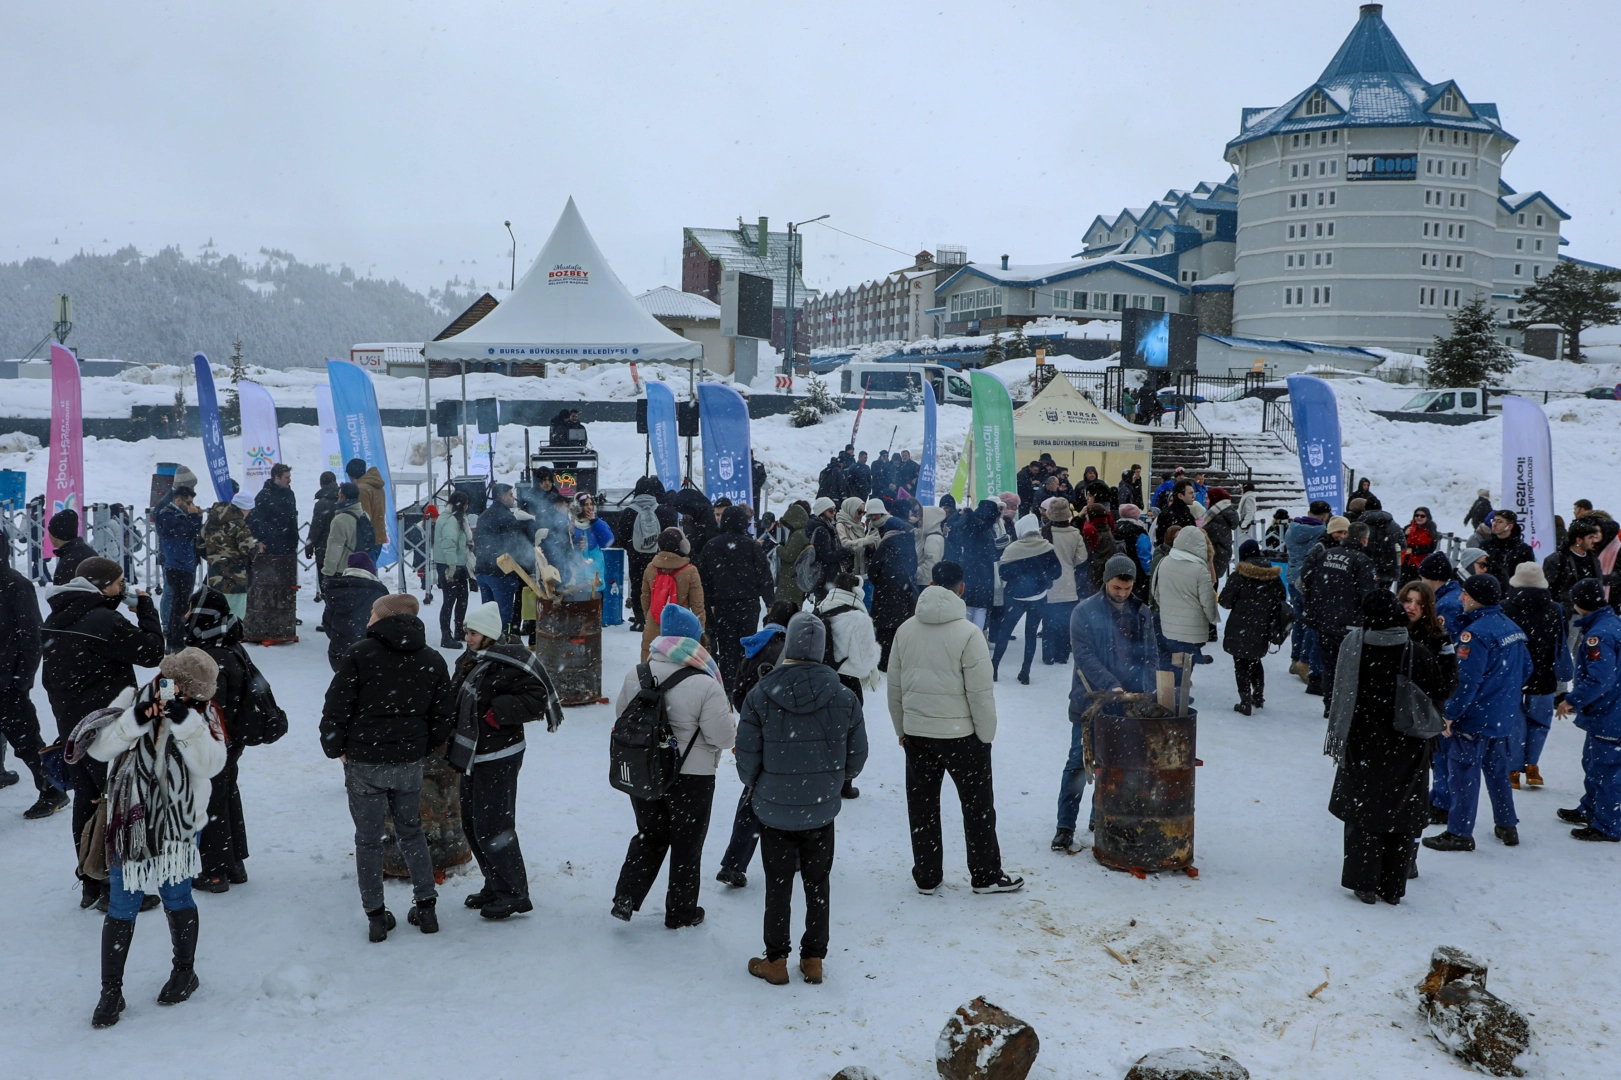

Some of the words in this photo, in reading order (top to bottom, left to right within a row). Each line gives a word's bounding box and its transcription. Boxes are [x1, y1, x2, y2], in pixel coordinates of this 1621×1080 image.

[1375, 156, 1417, 171] hotel
[549, 270, 589, 278] BOZBEY
[529, 346, 579, 356] BÜYÜKŞEHİR
[1066, 410, 1096, 418] BURSA
[1052, 439, 1088, 447] BÜYÜKŞEHİR
[1326, 553, 1350, 565] ÖZEL
[1323, 561, 1349, 571] GÜVENLİK
